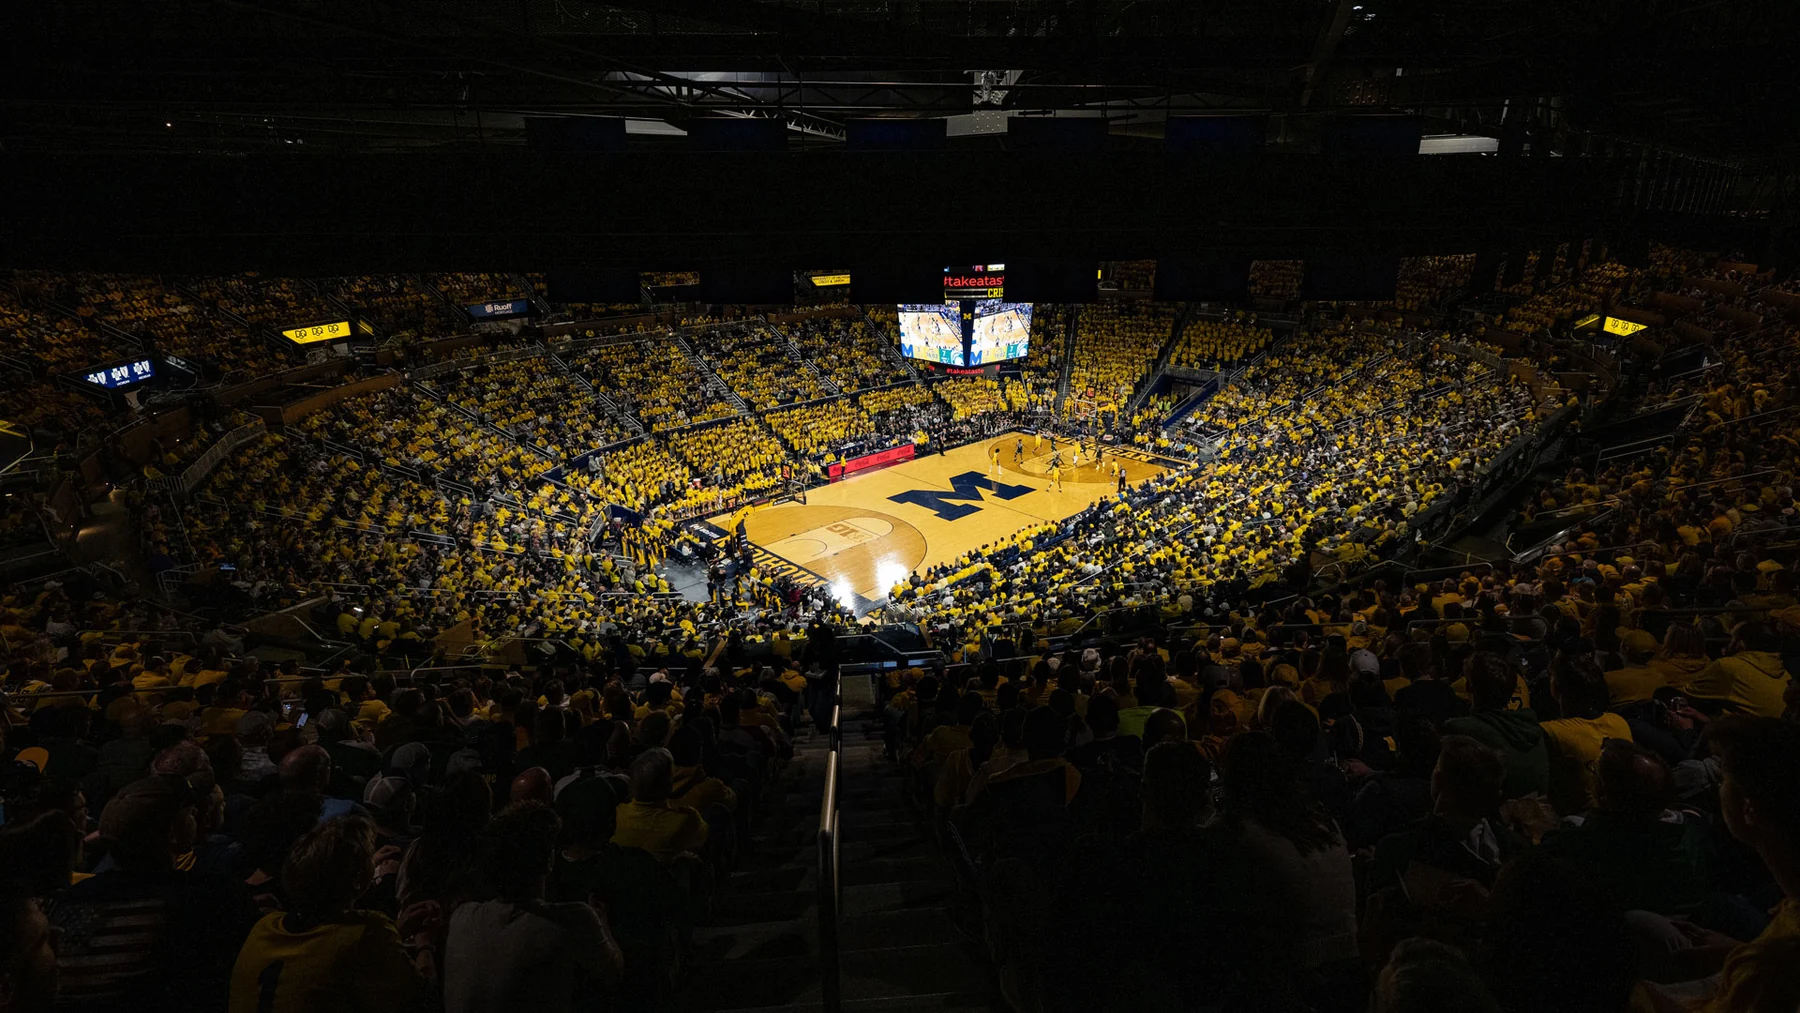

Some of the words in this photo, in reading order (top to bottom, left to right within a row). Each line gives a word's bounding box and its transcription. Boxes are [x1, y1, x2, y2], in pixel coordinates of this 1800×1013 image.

[944, 275, 1005, 287] #takeatas
[494, 303, 512, 311] Ruoff
[887, 470, 1036, 521] M
